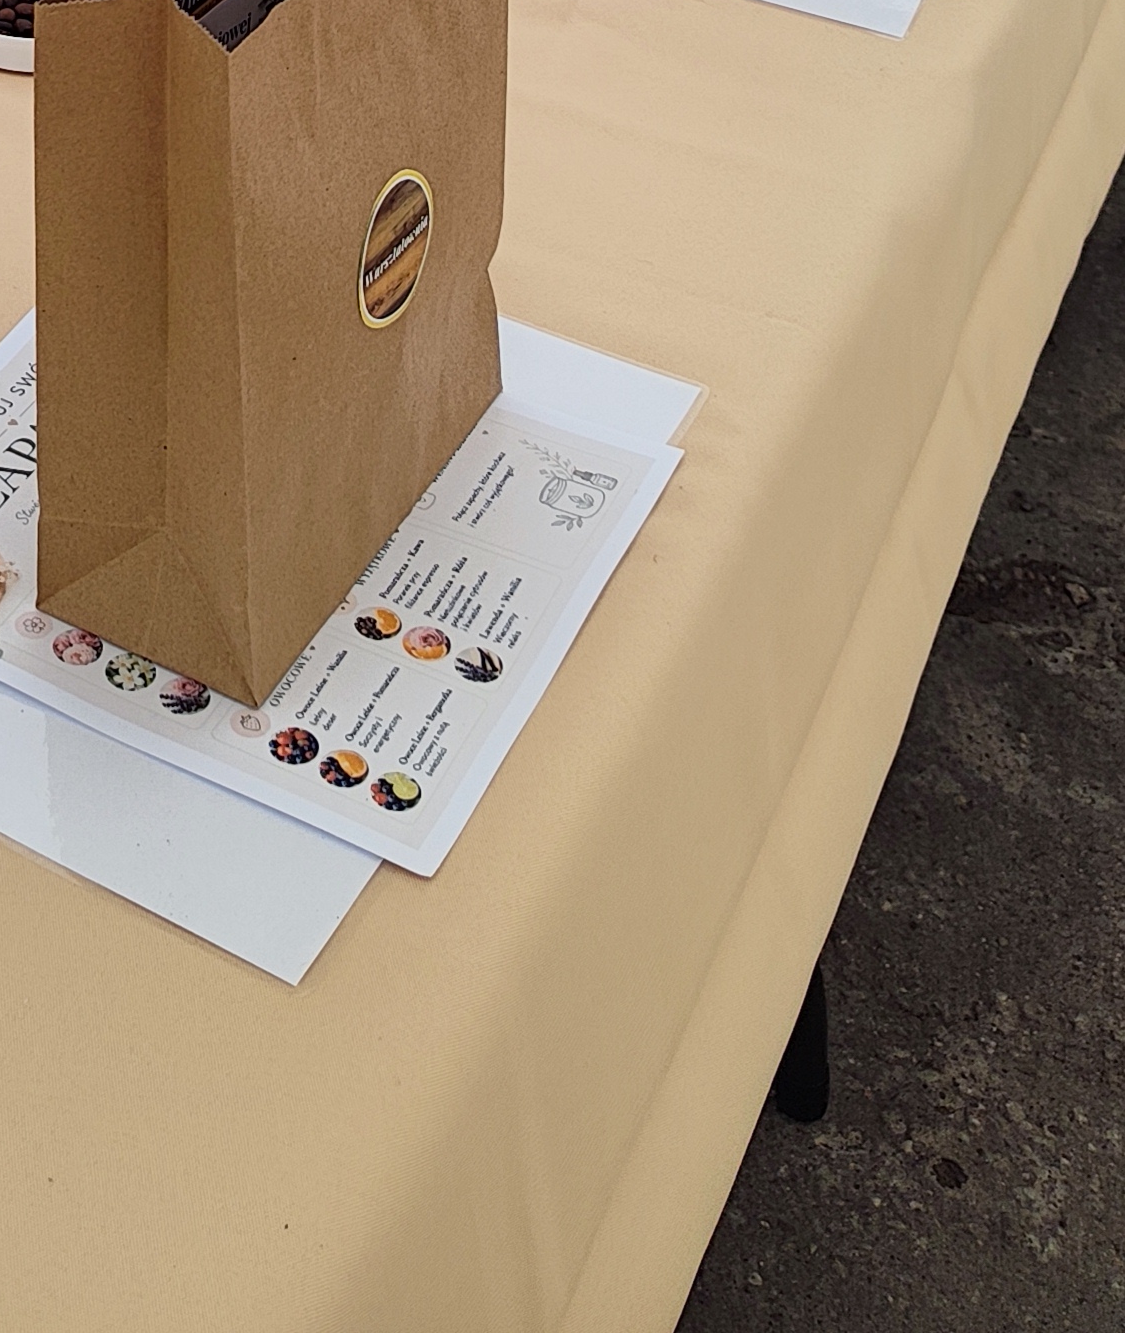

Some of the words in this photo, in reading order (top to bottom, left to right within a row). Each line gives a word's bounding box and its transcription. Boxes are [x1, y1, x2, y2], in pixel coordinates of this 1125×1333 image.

[10, 362, 37, 396] SWÓ
[408, 539, 425, 558] Kawa
[479, 609, 503, 640] Lawenda
[269, 653, 312, 707] OWOCOWE
